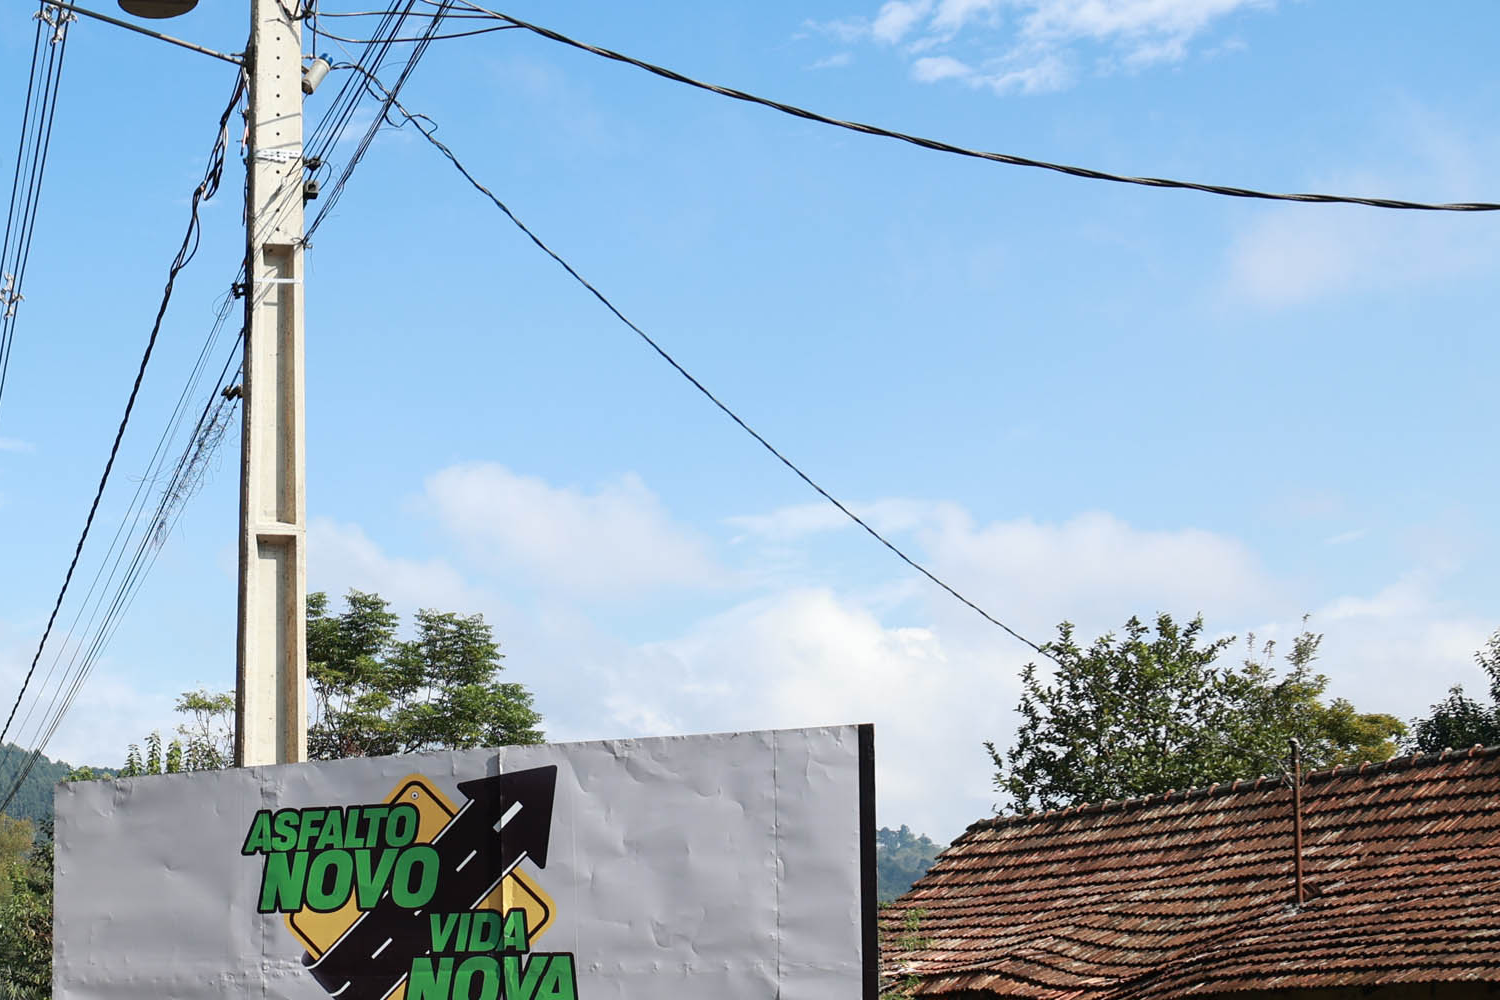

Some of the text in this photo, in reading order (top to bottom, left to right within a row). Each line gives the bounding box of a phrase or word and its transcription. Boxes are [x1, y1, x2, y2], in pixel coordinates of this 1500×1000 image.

[242, 803, 420, 855] ASFALTO
[258, 844, 440, 913] NOVO
[429, 908, 530, 954] VIDA
